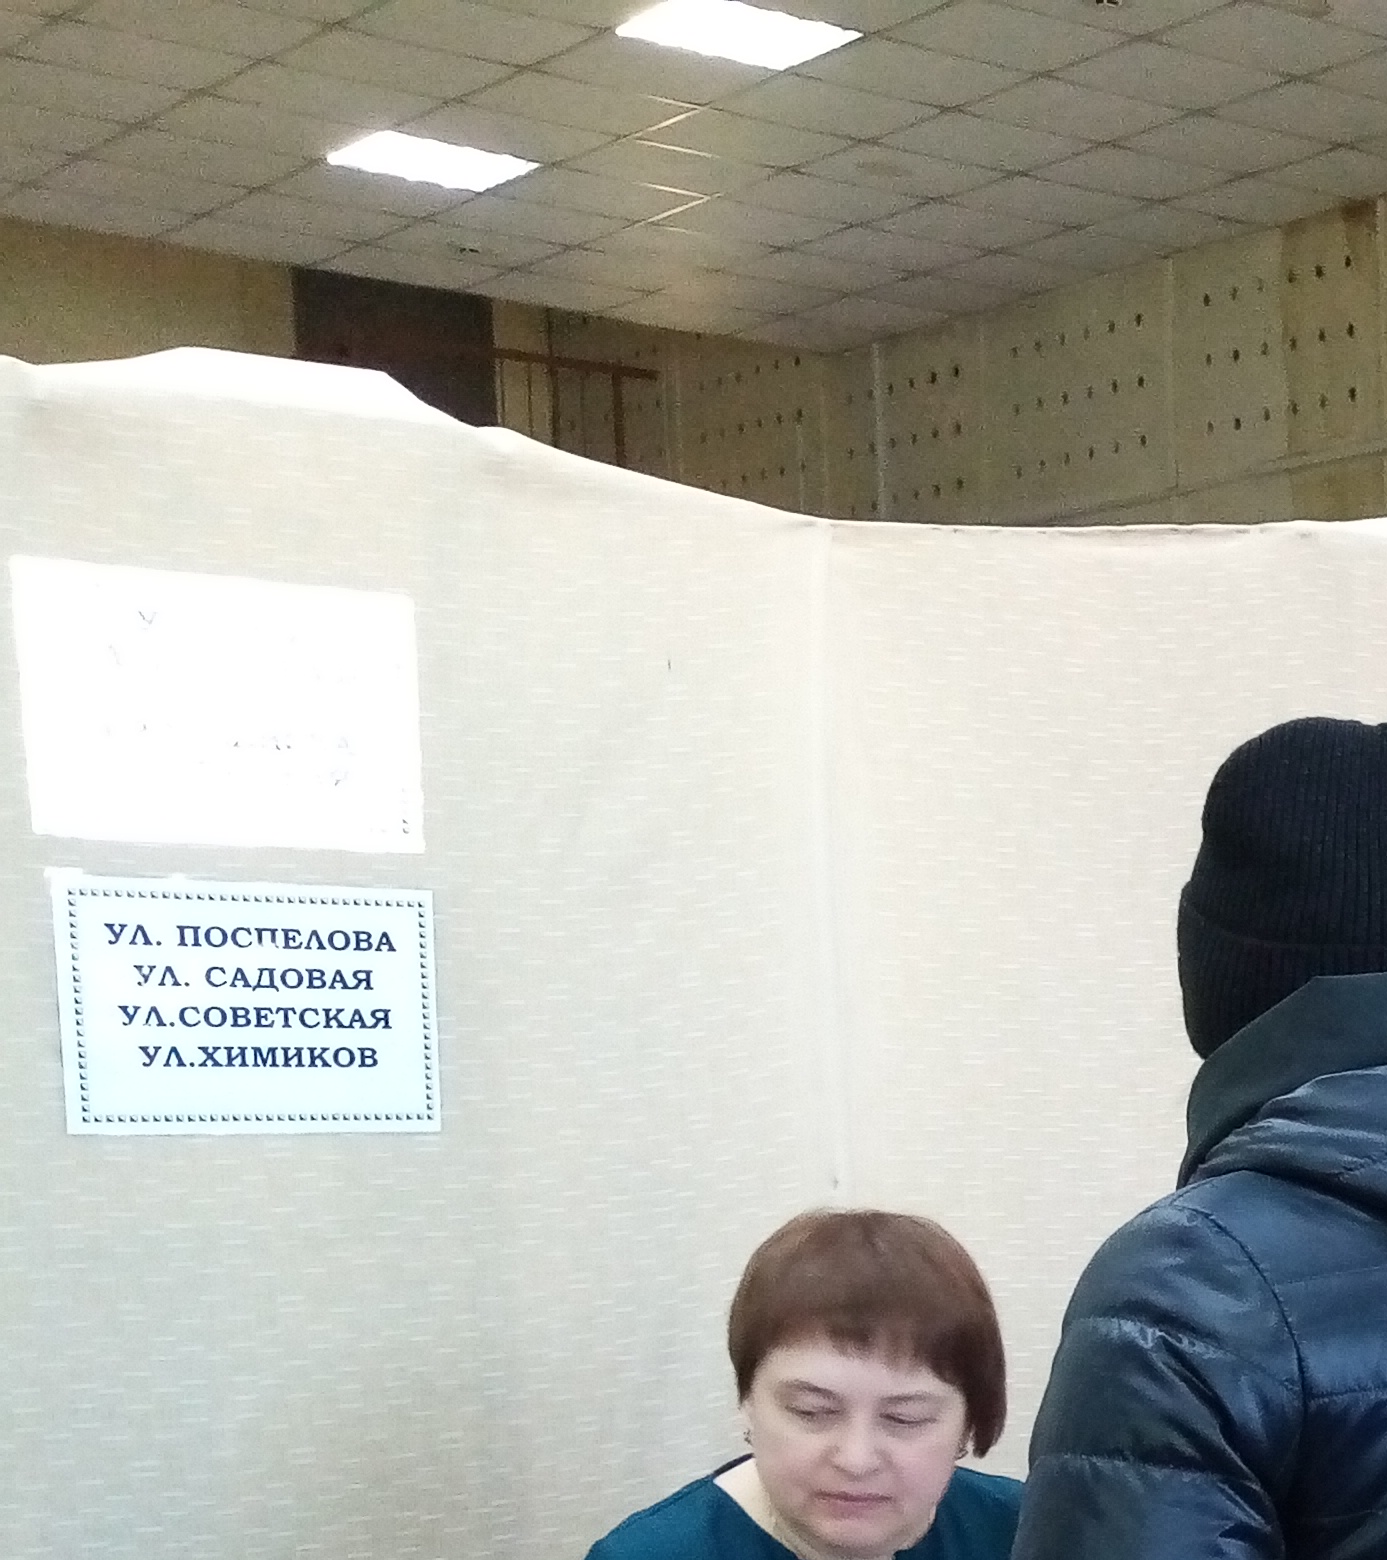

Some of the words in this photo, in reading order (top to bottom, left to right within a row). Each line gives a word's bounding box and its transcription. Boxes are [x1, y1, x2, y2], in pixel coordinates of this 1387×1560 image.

[104, 923, 162, 946] УЛ.
[176, 925, 397, 952] ПОСПЕЛОВА
[133, 965, 190, 987] УЛ.
[204, 966, 374, 992] САДОВАЯ
